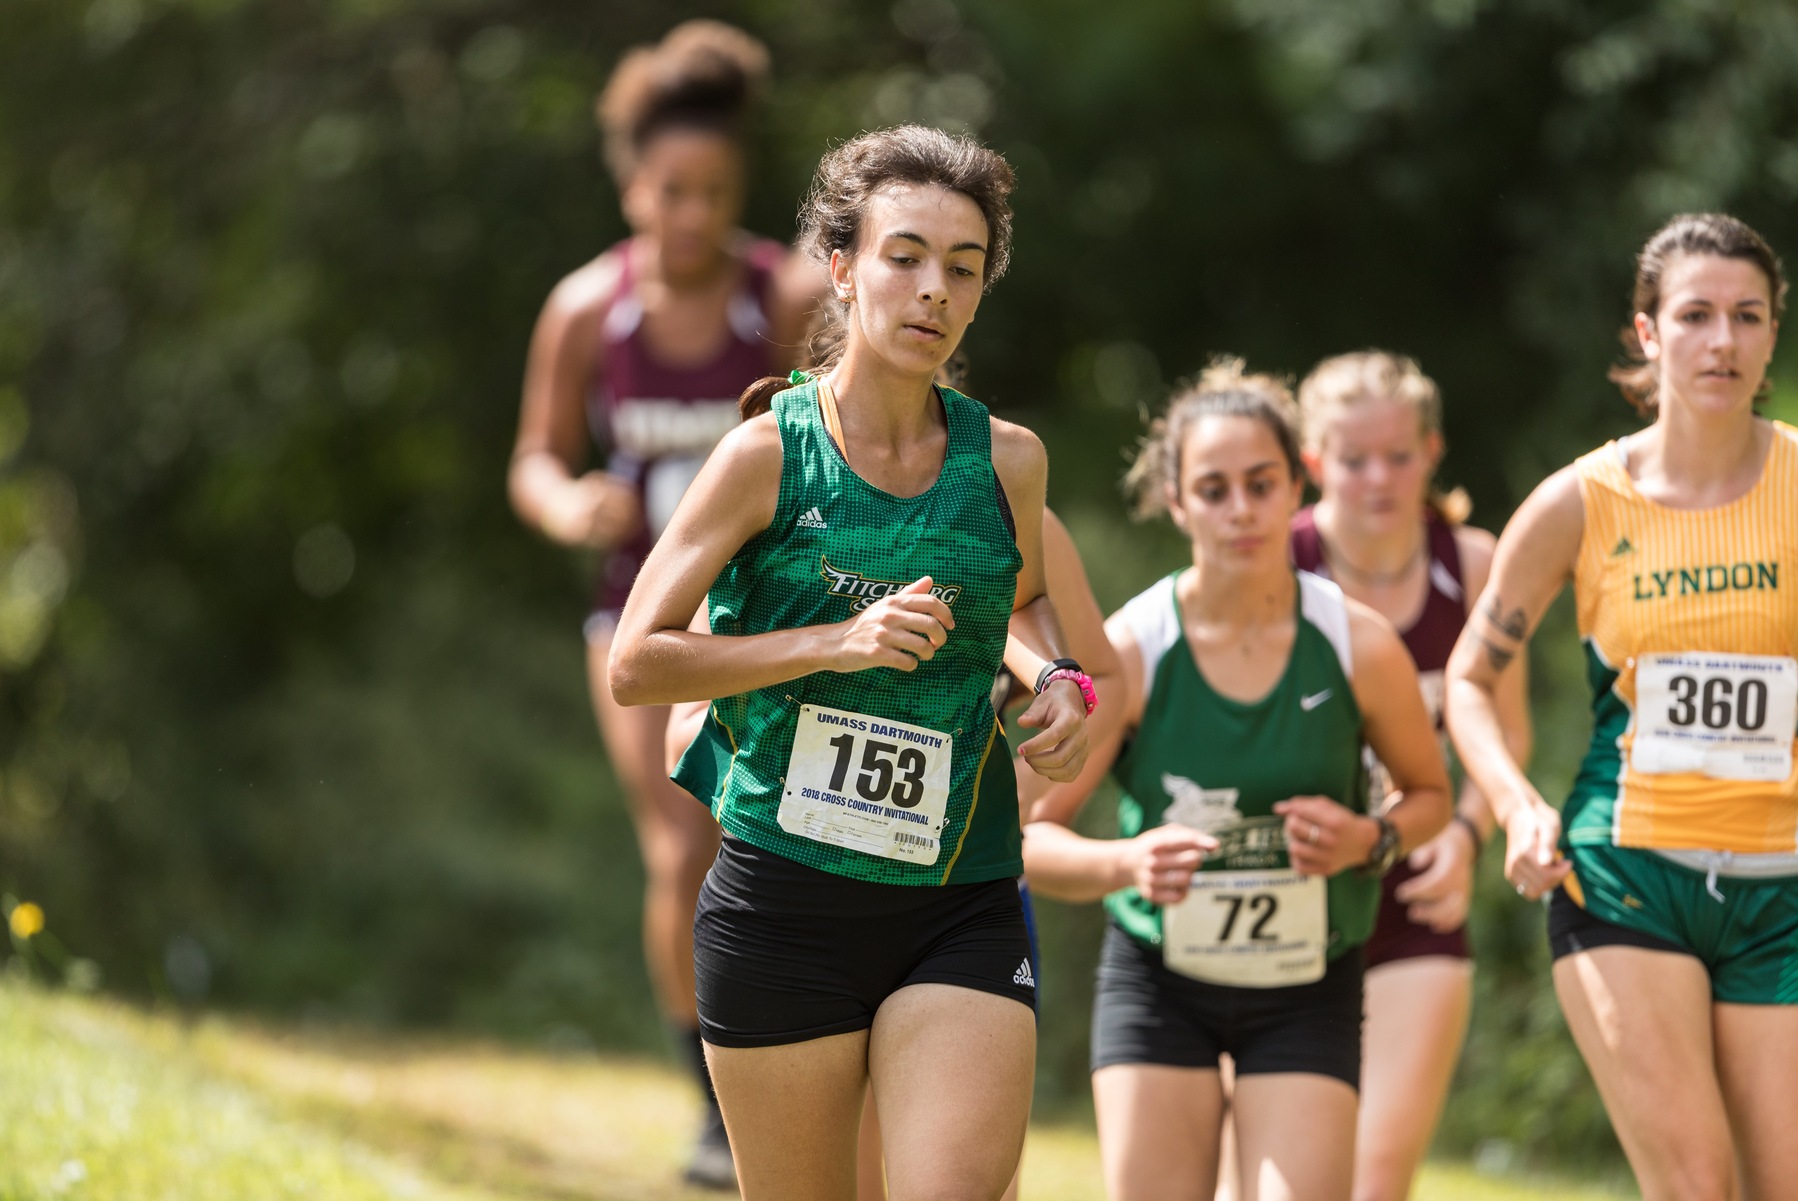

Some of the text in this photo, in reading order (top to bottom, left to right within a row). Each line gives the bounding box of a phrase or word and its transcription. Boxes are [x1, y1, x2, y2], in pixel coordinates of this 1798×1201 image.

[796, 519, 828, 529] adidas
[824, 564, 959, 604] FITCHRG
[1634, 561, 1778, 601] LYNDON
[1667, 675, 1768, 731] 360
[817, 713, 943, 749] UMASS DARTMOUTH
[828, 733, 927, 809] 153
[801, 787, 820, 800] 2018
[820, 792, 847, 807] CROSS
[847, 798, 884, 816] COUNTRY
[884, 807, 929, 826] INVITATIONAL
[1213, 893, 1279, 943] 72
